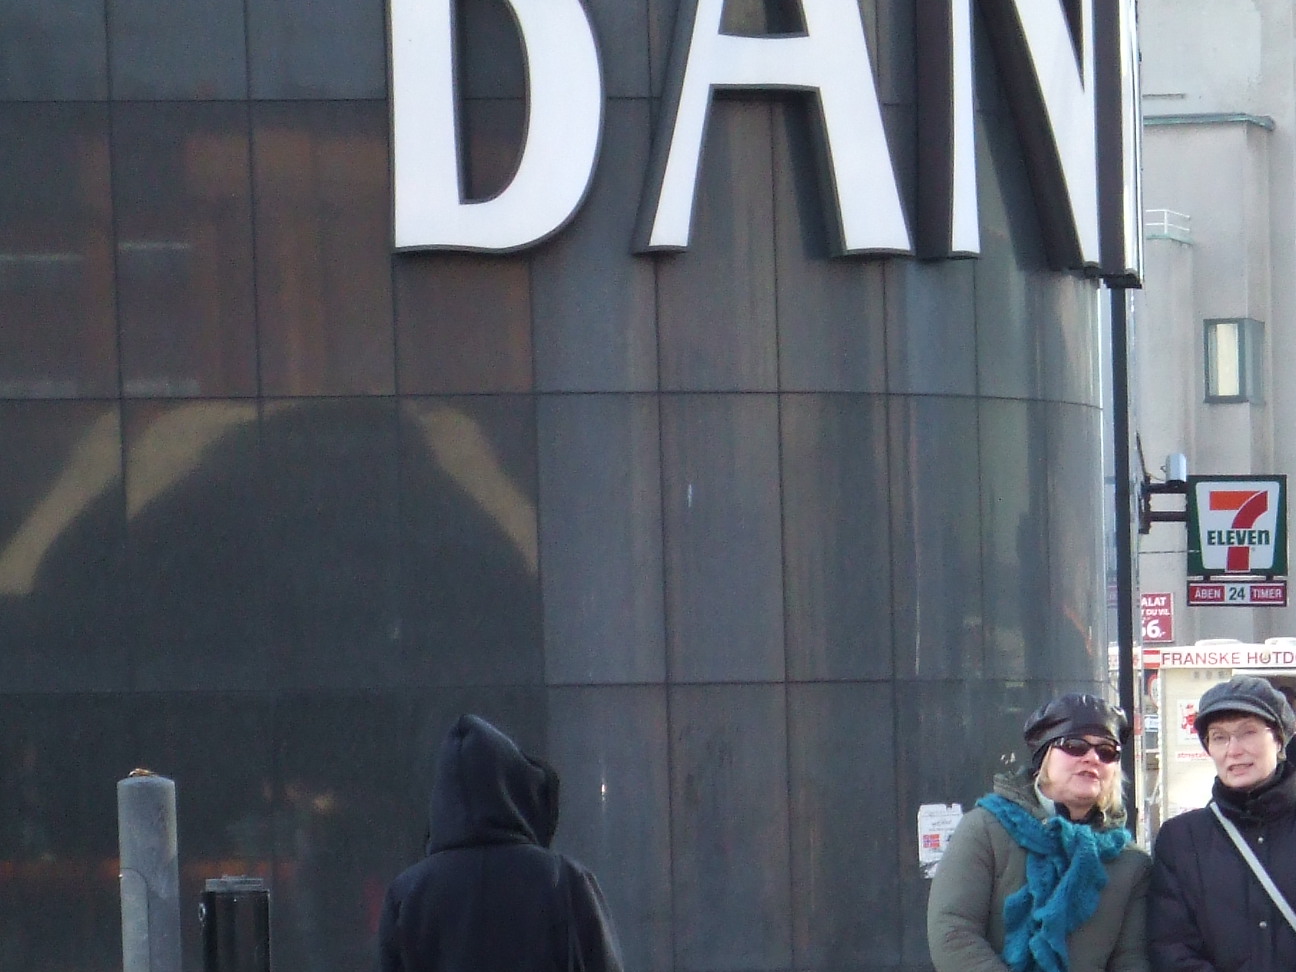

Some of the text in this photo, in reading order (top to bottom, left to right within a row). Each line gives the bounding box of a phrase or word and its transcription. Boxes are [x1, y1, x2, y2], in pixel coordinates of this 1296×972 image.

[1209, 490, 1268, 572] 7
[1229, 586, 1246, 601] 24
[1252, 586, 1282, 598] TIMER
[1141, 596, 1167, 607] ALAT
[1161, 650, 1240, 666] FRANSKE
